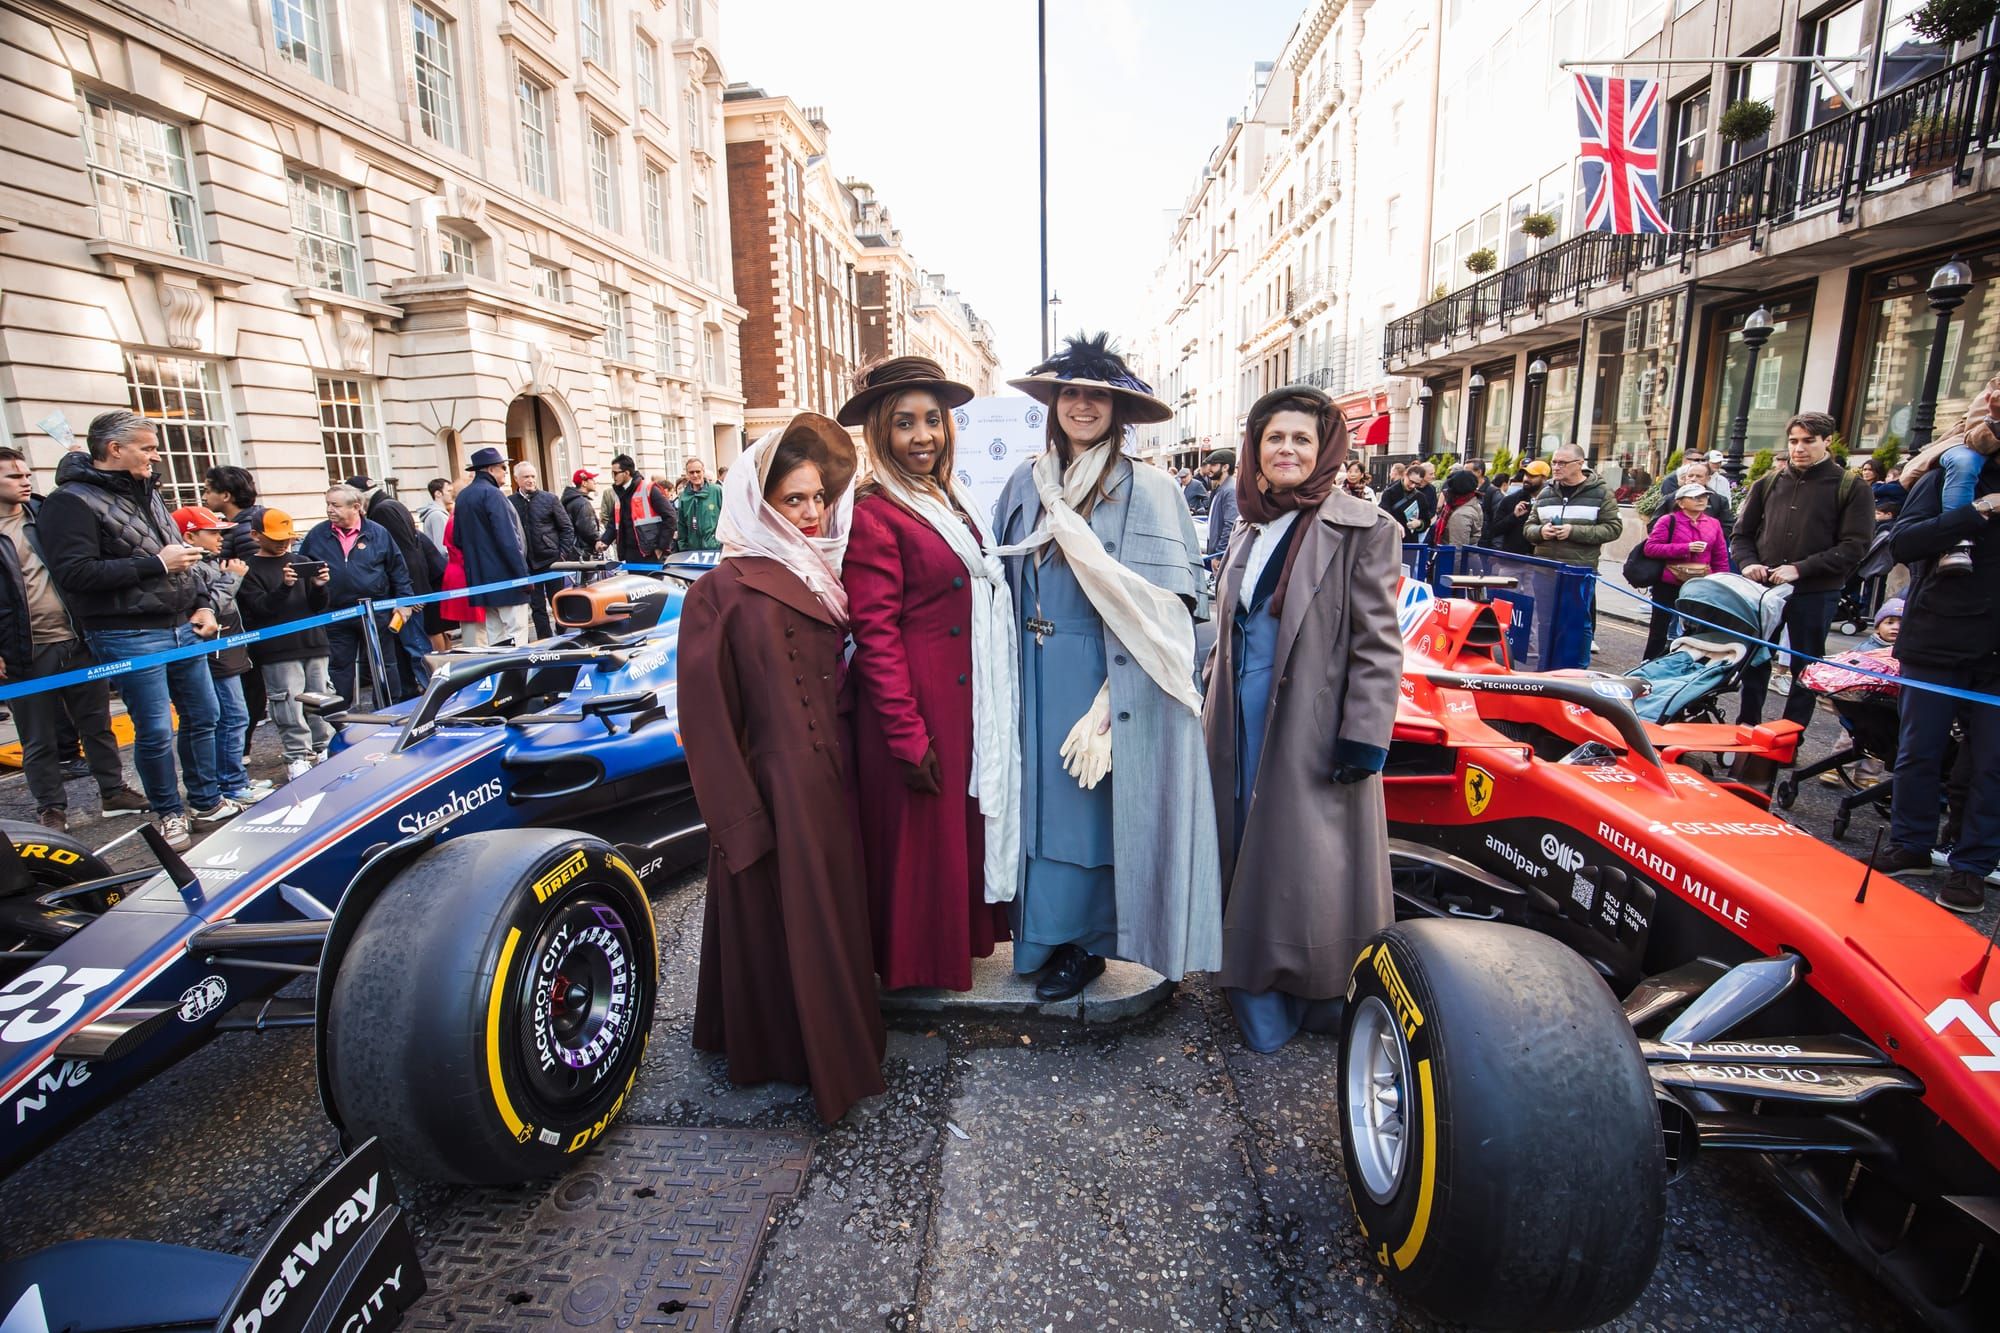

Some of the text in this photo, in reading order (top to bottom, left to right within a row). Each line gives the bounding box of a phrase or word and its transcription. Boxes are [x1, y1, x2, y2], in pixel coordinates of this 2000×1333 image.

[93, 661, 132, 674] ATLASSIAN
[1483, 681, 1544, 692] TECHNOLOGY
[231, 825, 301, 834] ATLASSIAN
[398, 777, 503, 835] Stephens
[13, 843, 80, 865] RO
[532, 850, 588, 904] PIRELLI
[1486, 834, 1543, 878] ambipar
[1598, 821, 1750, 929] RICHARD MILLE
[0, 965, 126, 1043] 23
[179, 979, 225, 1021] FIA
[535, 924, 568, 1072] JACKPOT CITY
[1373, 943, 1424, 1042] PIRELLI
[593, 1048, 619, 1083] CITY
[1699, 1043, 1801, 1057] vantage
[232, 1172, 379, 1333] betway
[341, 1264, 402, 1333] CITY
